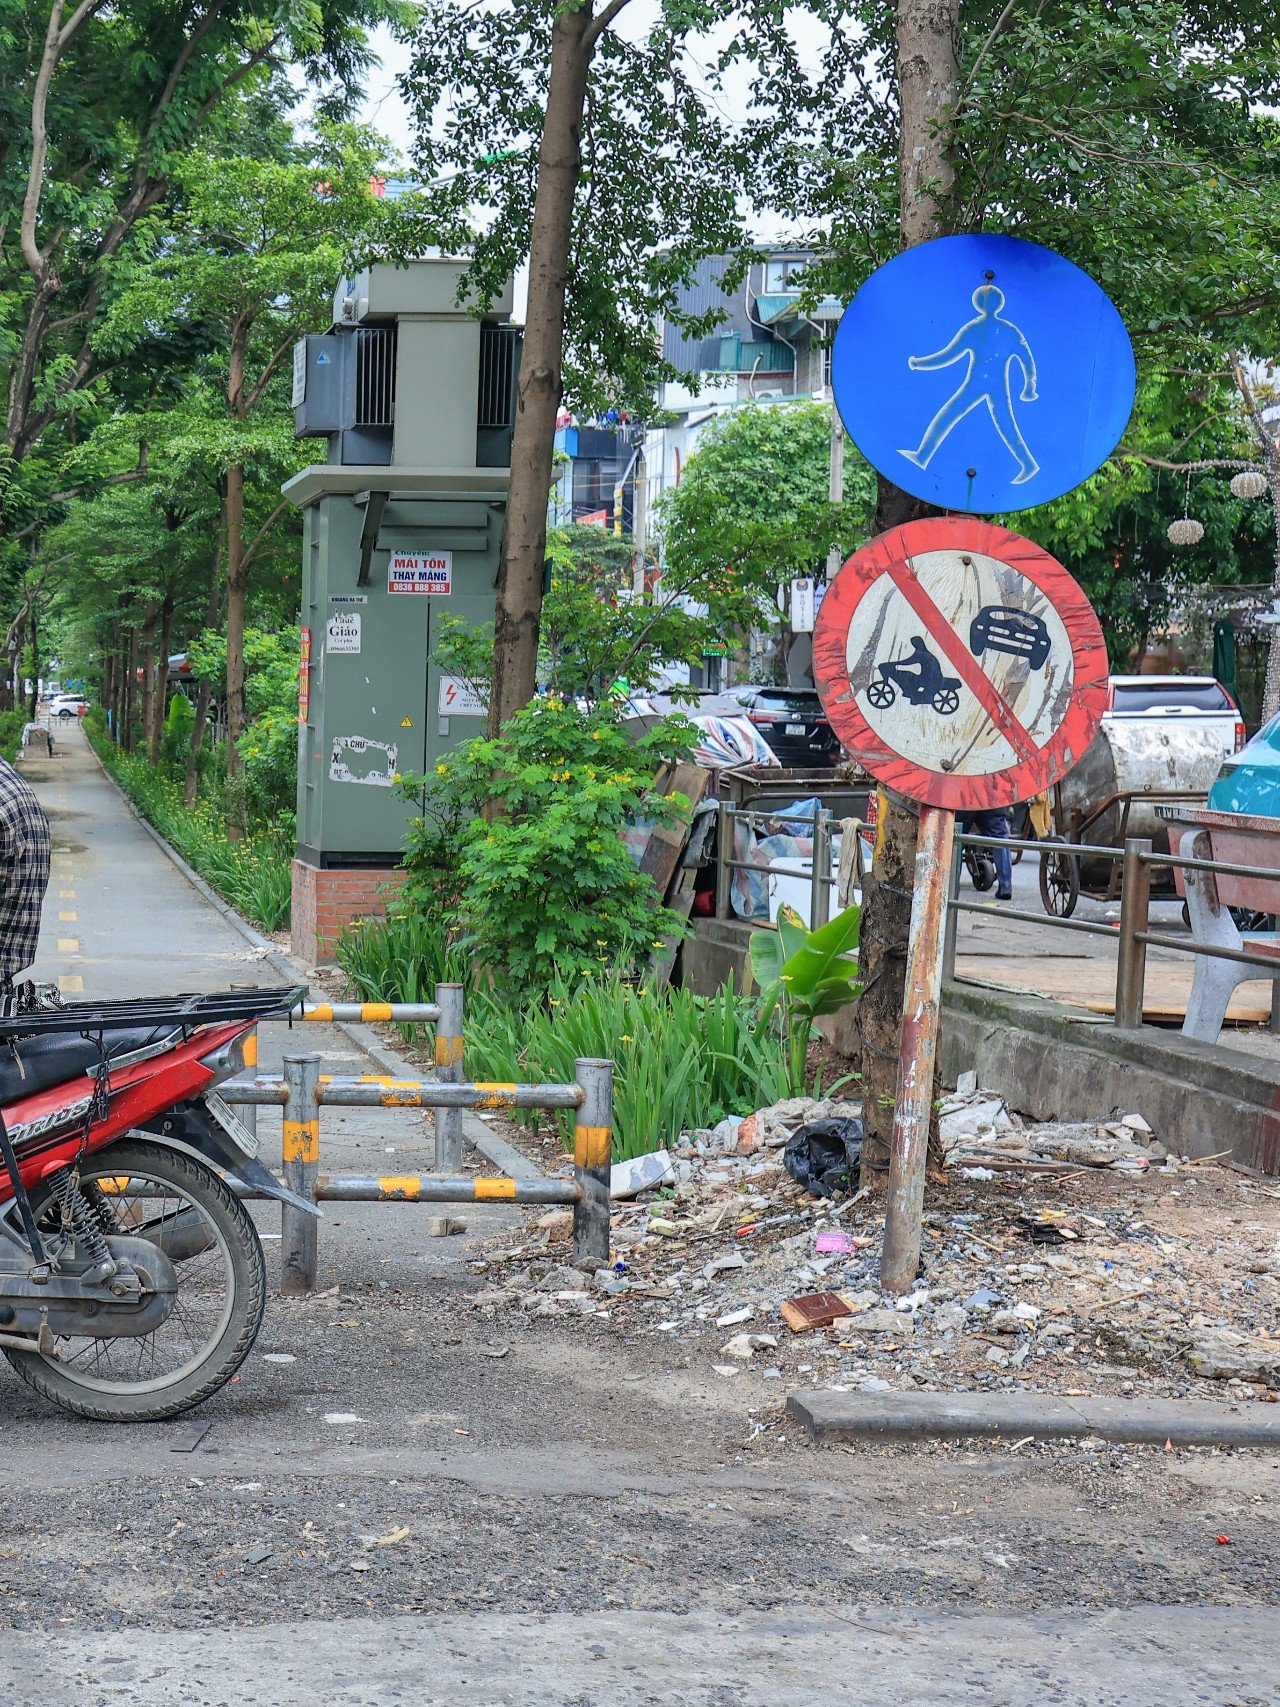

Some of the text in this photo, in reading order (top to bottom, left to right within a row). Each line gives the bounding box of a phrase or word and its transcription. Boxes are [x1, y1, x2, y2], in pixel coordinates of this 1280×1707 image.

[394, 557, 446, 569] MÁI TÔN
[393, 571, 416, 581] THAY
[329, 625, 358, 637] Giáo
